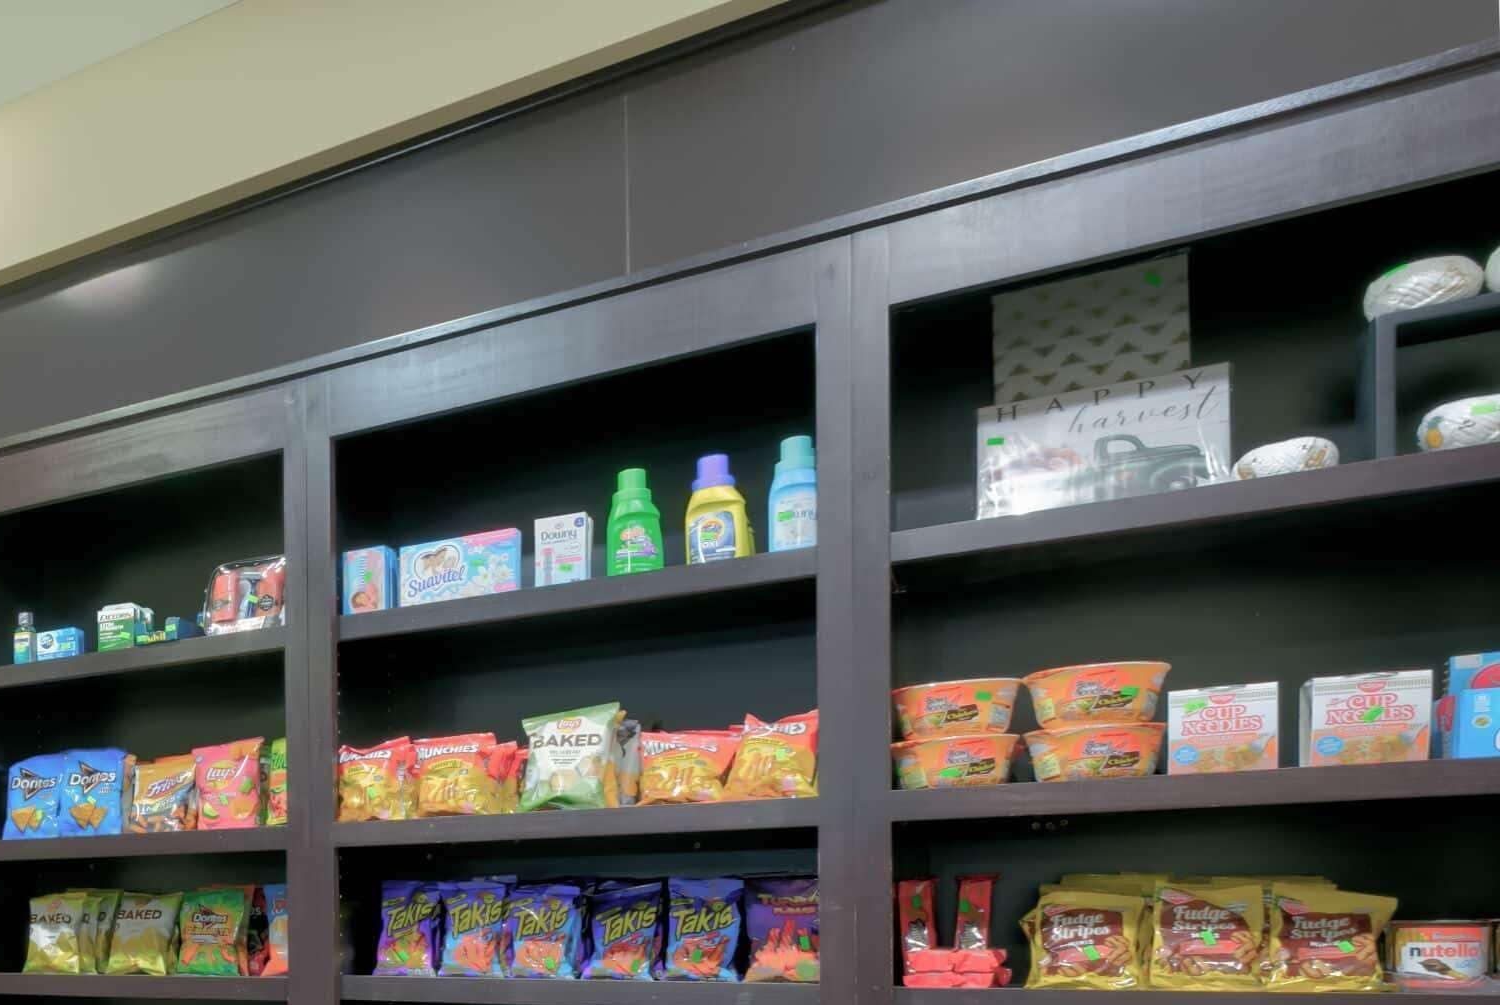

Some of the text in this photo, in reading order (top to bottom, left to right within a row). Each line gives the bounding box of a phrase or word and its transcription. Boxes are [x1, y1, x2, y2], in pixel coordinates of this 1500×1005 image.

[996, 371, 1205, 423] HAPPY
[1068, 385, 1220, 433] harvest
[540, 527, 578, 541] Downy
[407, 565, 465, 598] Suavitel
[1346, 692, 1398, 709] CUP
[1200, 704, 1246, 721] CUP
[1326, 704, 1415, 725] NOOLES
[1181, 715, 1265, 736] NOODLES
[532, 732, 602, 749] BAKED
[416, 743, 479, 762] MUNCHIES
[11, 774, 58, 791] Doritos
[69, 769, 116, 786] Doritos
[116, 909, 162, 920] BAKED
[387, 903, 431, 938] Takis
[451, 901, 503, 939] Takis
[514, 904, 568, 940] Takis
[671, 905, 734, 940] Takis
[1051, 913, 1104, 926] Fudge
[1173, 905, 1230, 922] Fudge
[1290, 915, 1350, 930] Fudge
[601, 906, 658, 945] Takis
[1051, 925, 1111, 941] Stripes
[1409, 940, 1480, 958] nutella
